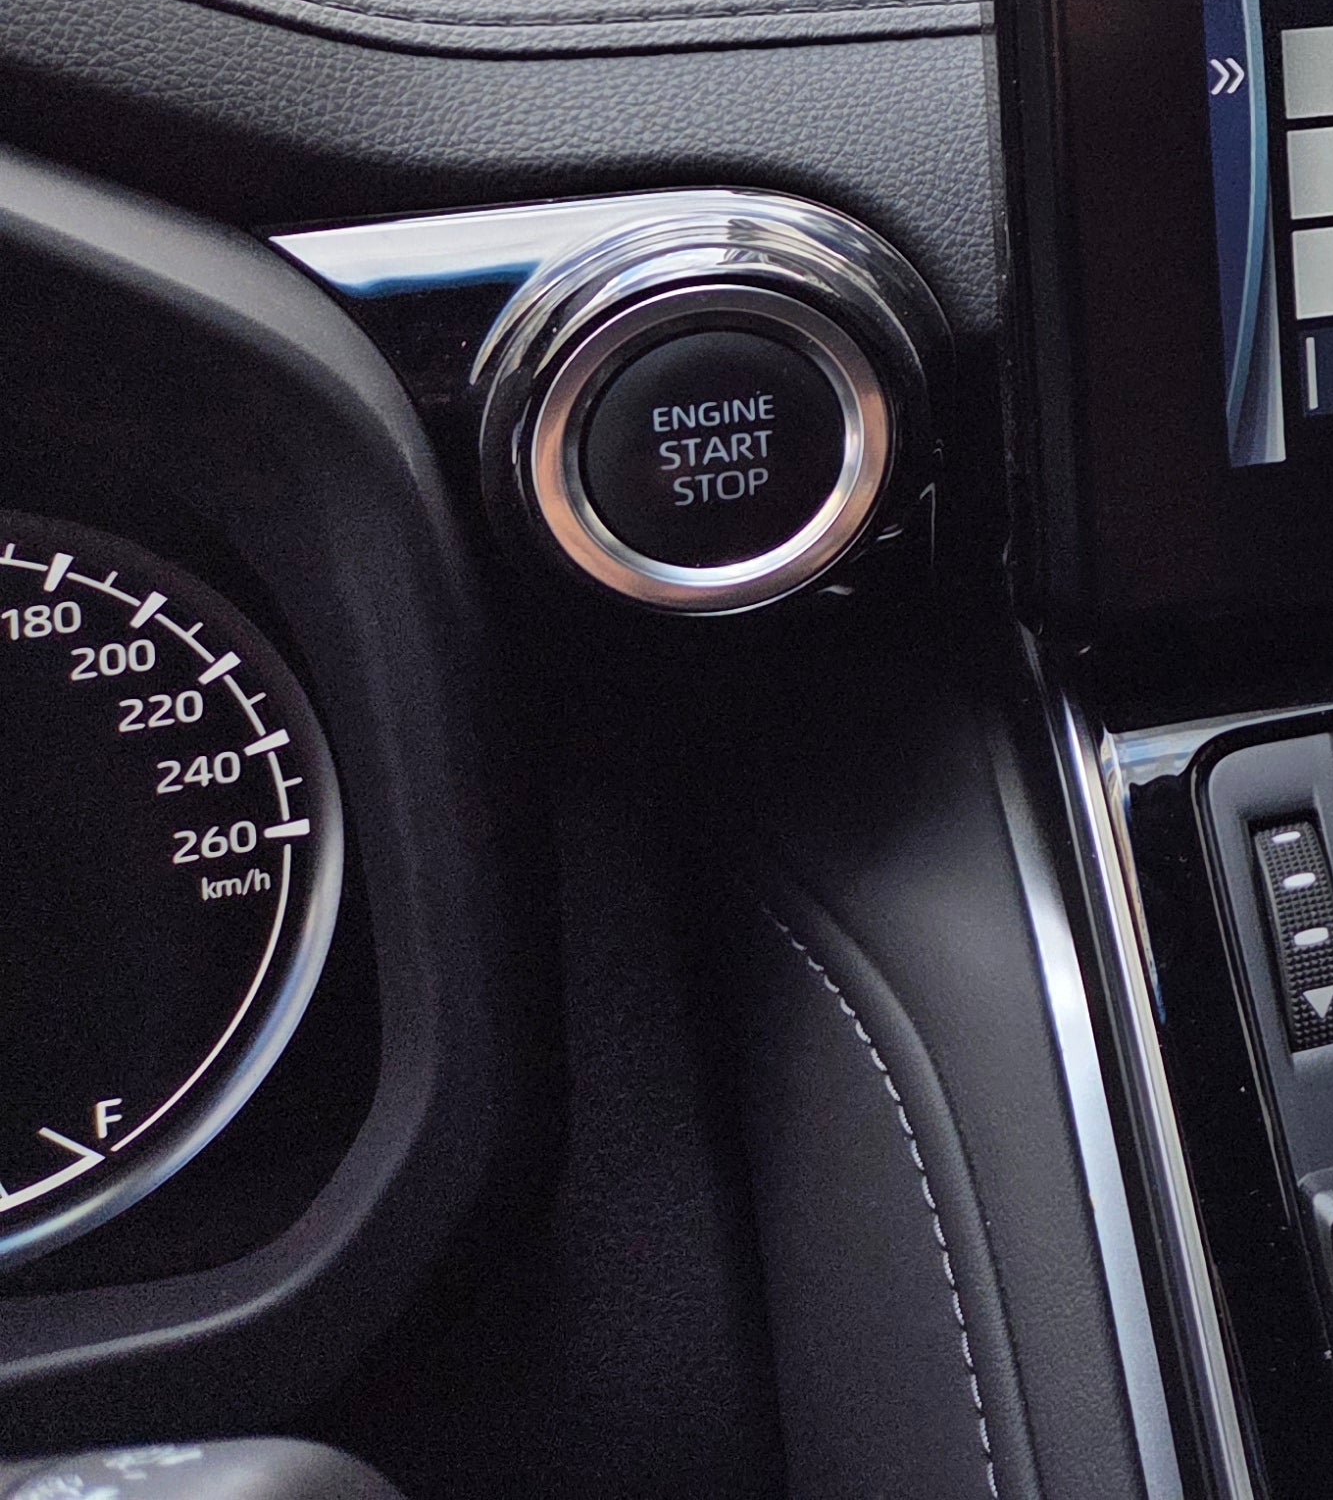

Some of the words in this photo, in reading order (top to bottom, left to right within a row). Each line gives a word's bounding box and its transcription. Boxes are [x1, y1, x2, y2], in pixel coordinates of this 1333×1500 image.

[653, 395, 776, 433] ENGINE
[659, 430, 773, 471] START
[673, 468, 769, 506] STOP
[1, 601, 82, 641] 180
[70, 638, 156, 681] 200
[118, 689, 204, 733] 220
[156, 750, 241, 795] 240
[172, 820, 258, 864] 260
[201, 868, 271, 902] km/h
[95, 1099, 123, 1138] F
